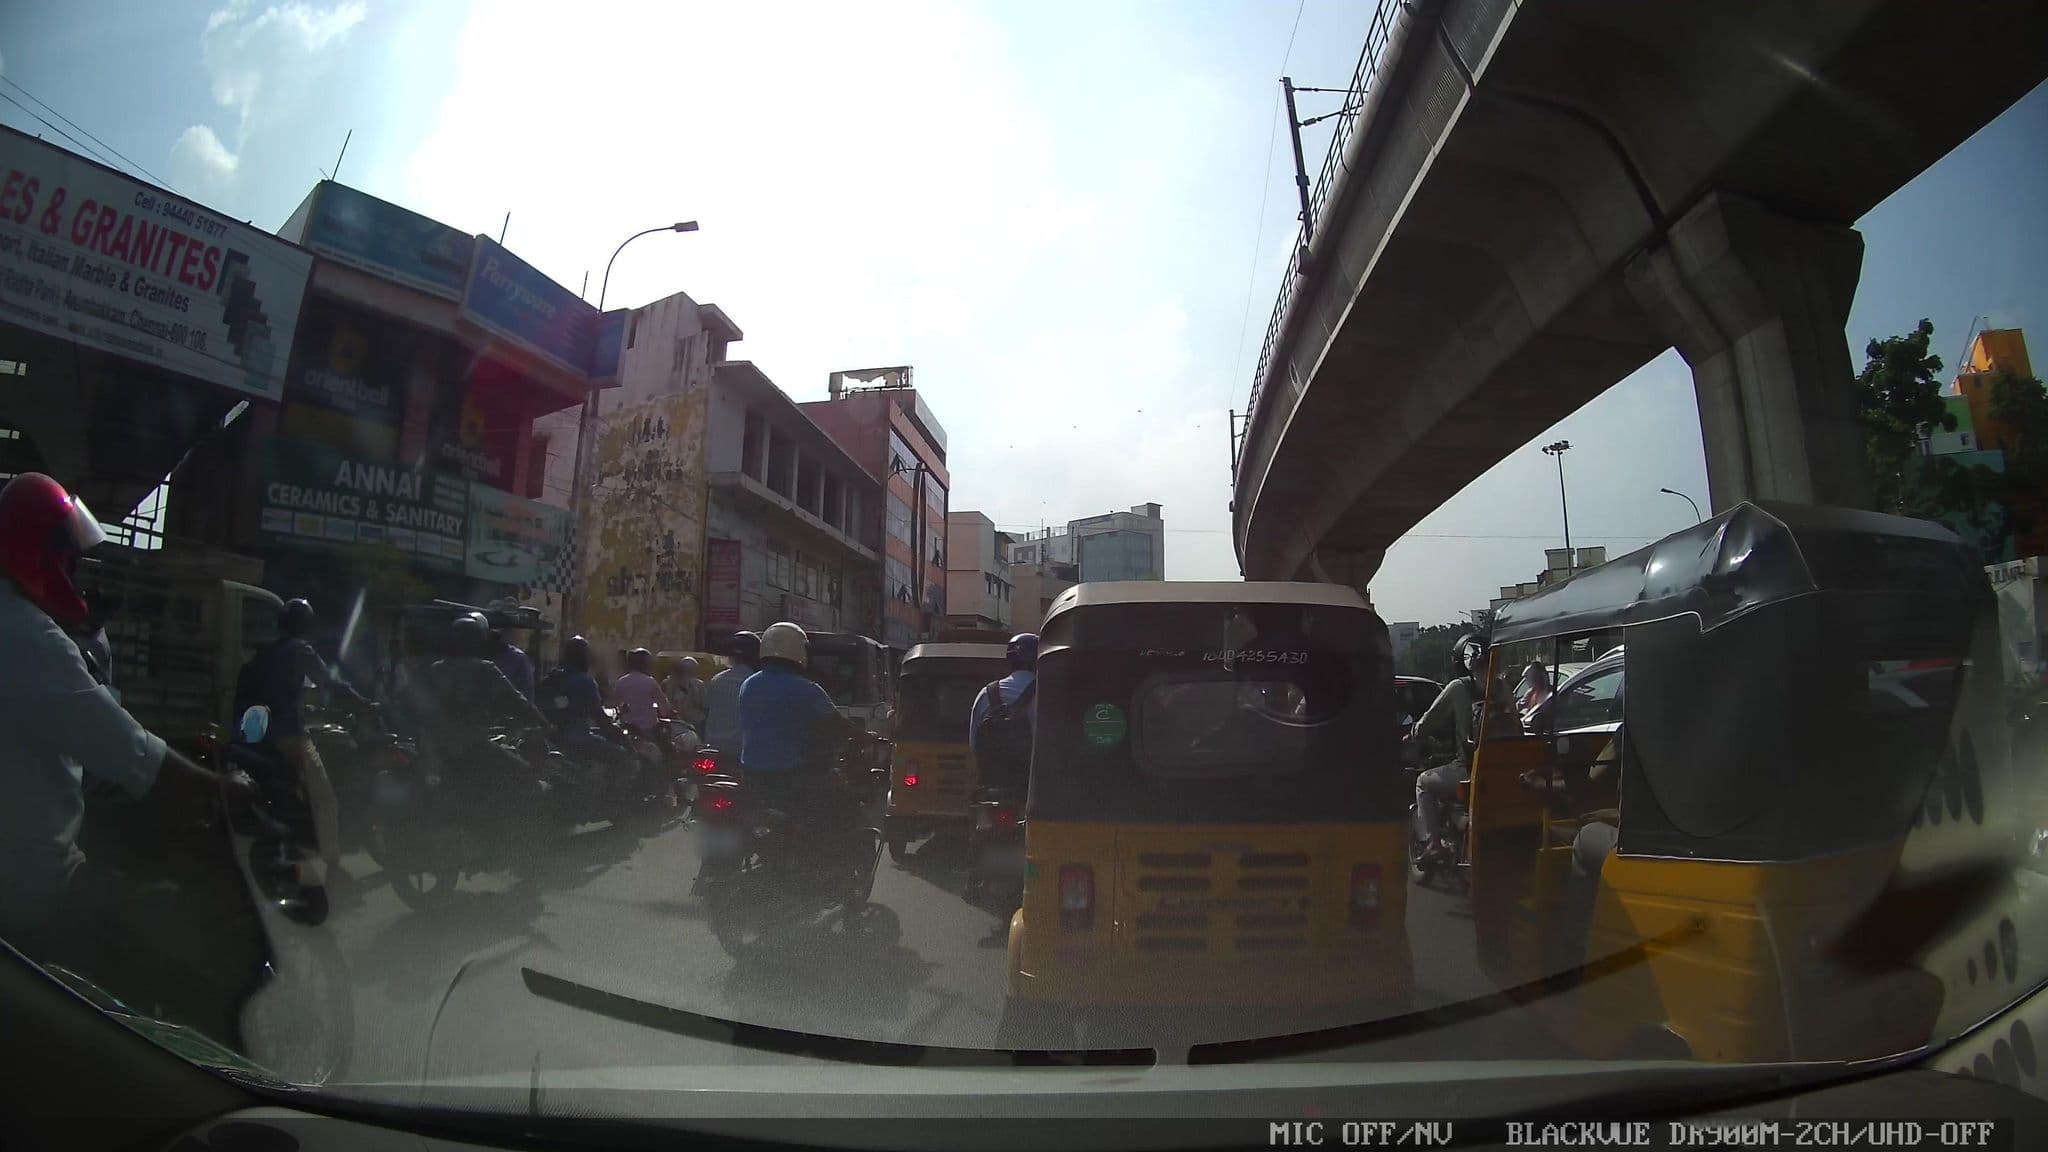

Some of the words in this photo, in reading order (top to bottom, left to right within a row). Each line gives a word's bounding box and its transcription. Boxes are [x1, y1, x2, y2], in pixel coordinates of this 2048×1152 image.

[40, 186, 66, 235] &
[71, 198, 221, 291] GRANITES
[71, 255, 117, 289] Marble
[119, 271, 130, 292] &
[134, 277, 190, 313] Granites
[334, 460, 422, 499] ANNAI
[268, 482, 360, 517] CERAMICS
[366, 502, 378, 518] &
[386, 503, 463, 535] SANITARY
